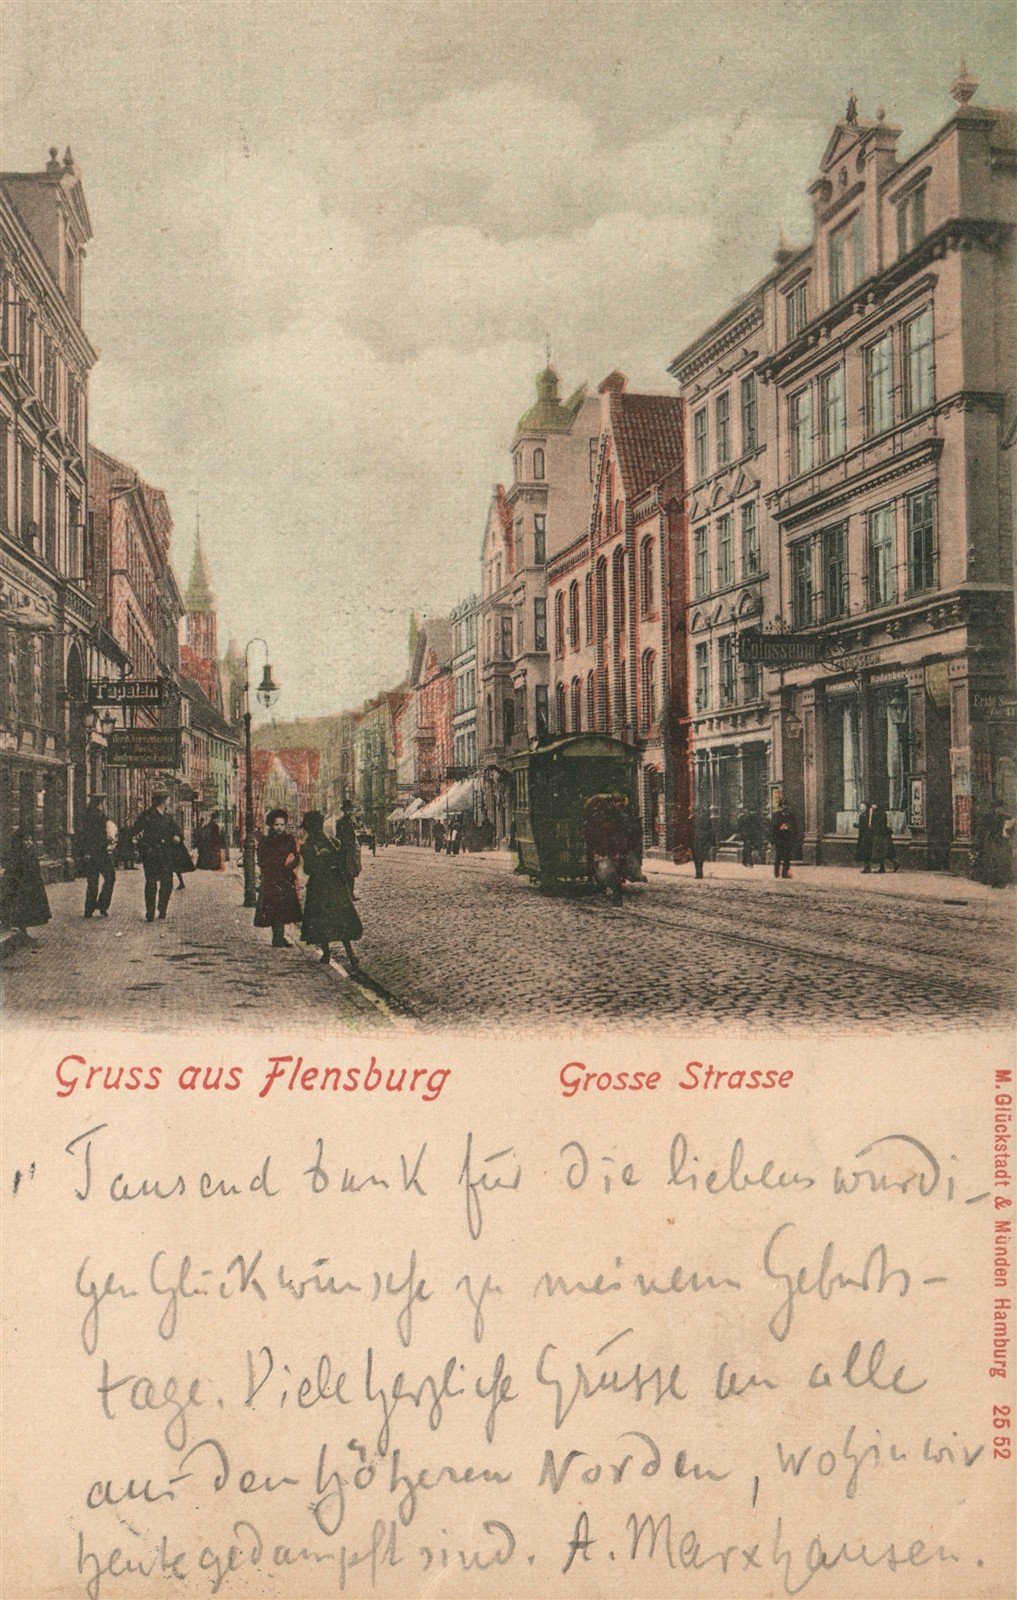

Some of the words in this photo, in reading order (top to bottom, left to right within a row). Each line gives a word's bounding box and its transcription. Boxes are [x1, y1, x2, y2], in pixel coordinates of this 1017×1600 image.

[741, 637, 816, 660] Colosseum
[92, 683, 160, 701] Tapeten
[65, 1123, 280, 1201] Tausend
[561, 1141, 639, 1194] die
[809, 1339, 927, 1394] alle
